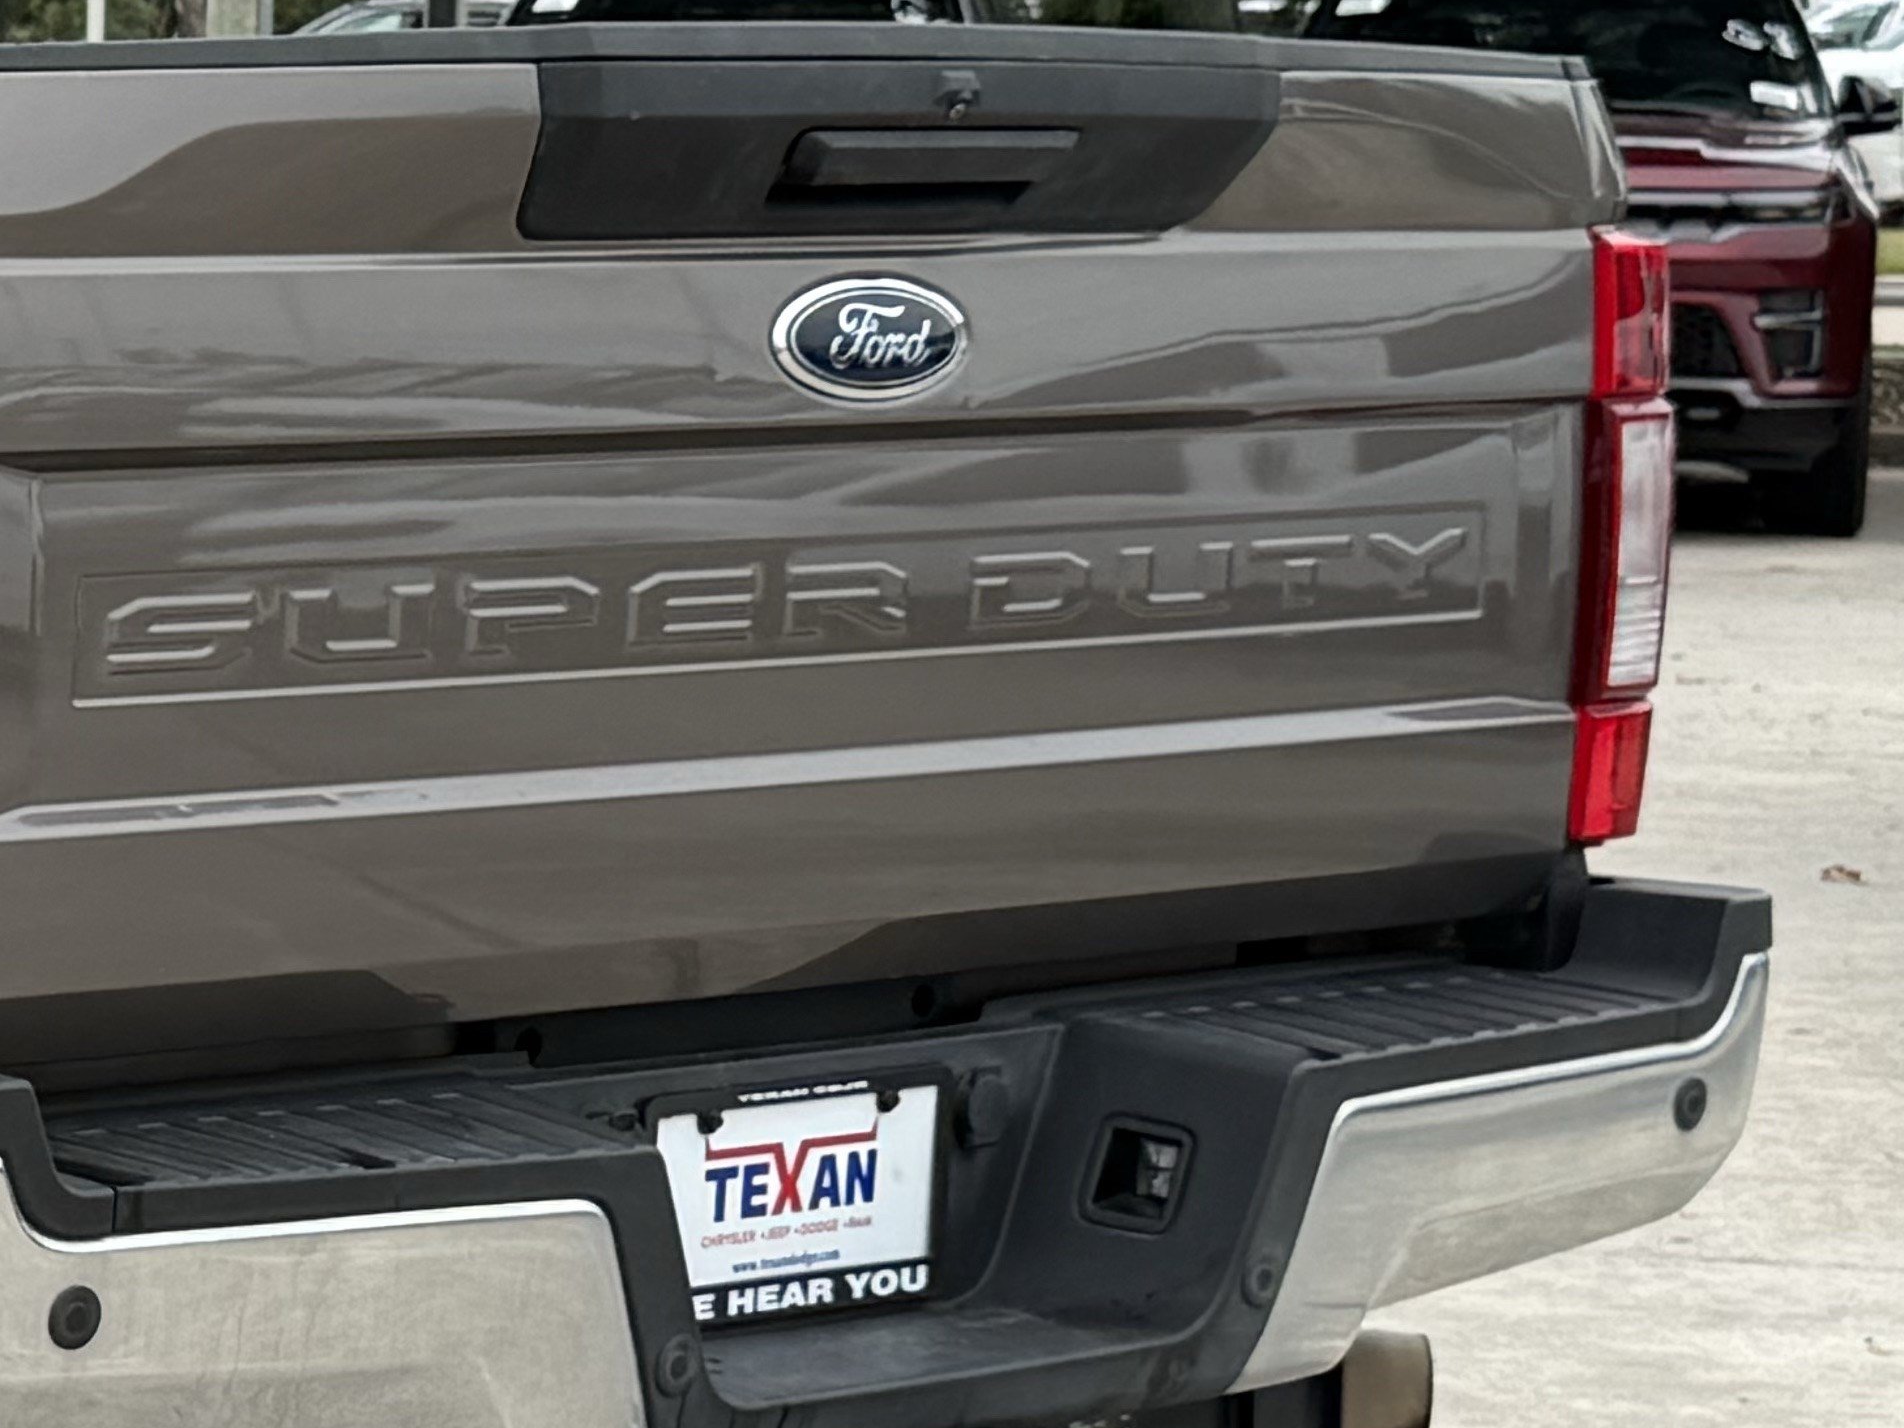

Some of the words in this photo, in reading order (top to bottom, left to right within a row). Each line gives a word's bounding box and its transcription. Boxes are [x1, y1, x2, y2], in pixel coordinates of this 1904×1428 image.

[829, 302, 932, 370] Ford
[104, 562, 909, 675] SUPER
[969, 527, 1469, 634] DUTY
[704, 1136, 878, 1223] TEXAN
[700, 1230, 756, 1249] CHRYSLER
[692, 1293, 716, 1321] E
[726, 1277, 835, 1317] HEAR
[845, 1264, 930, 1300] YOU
